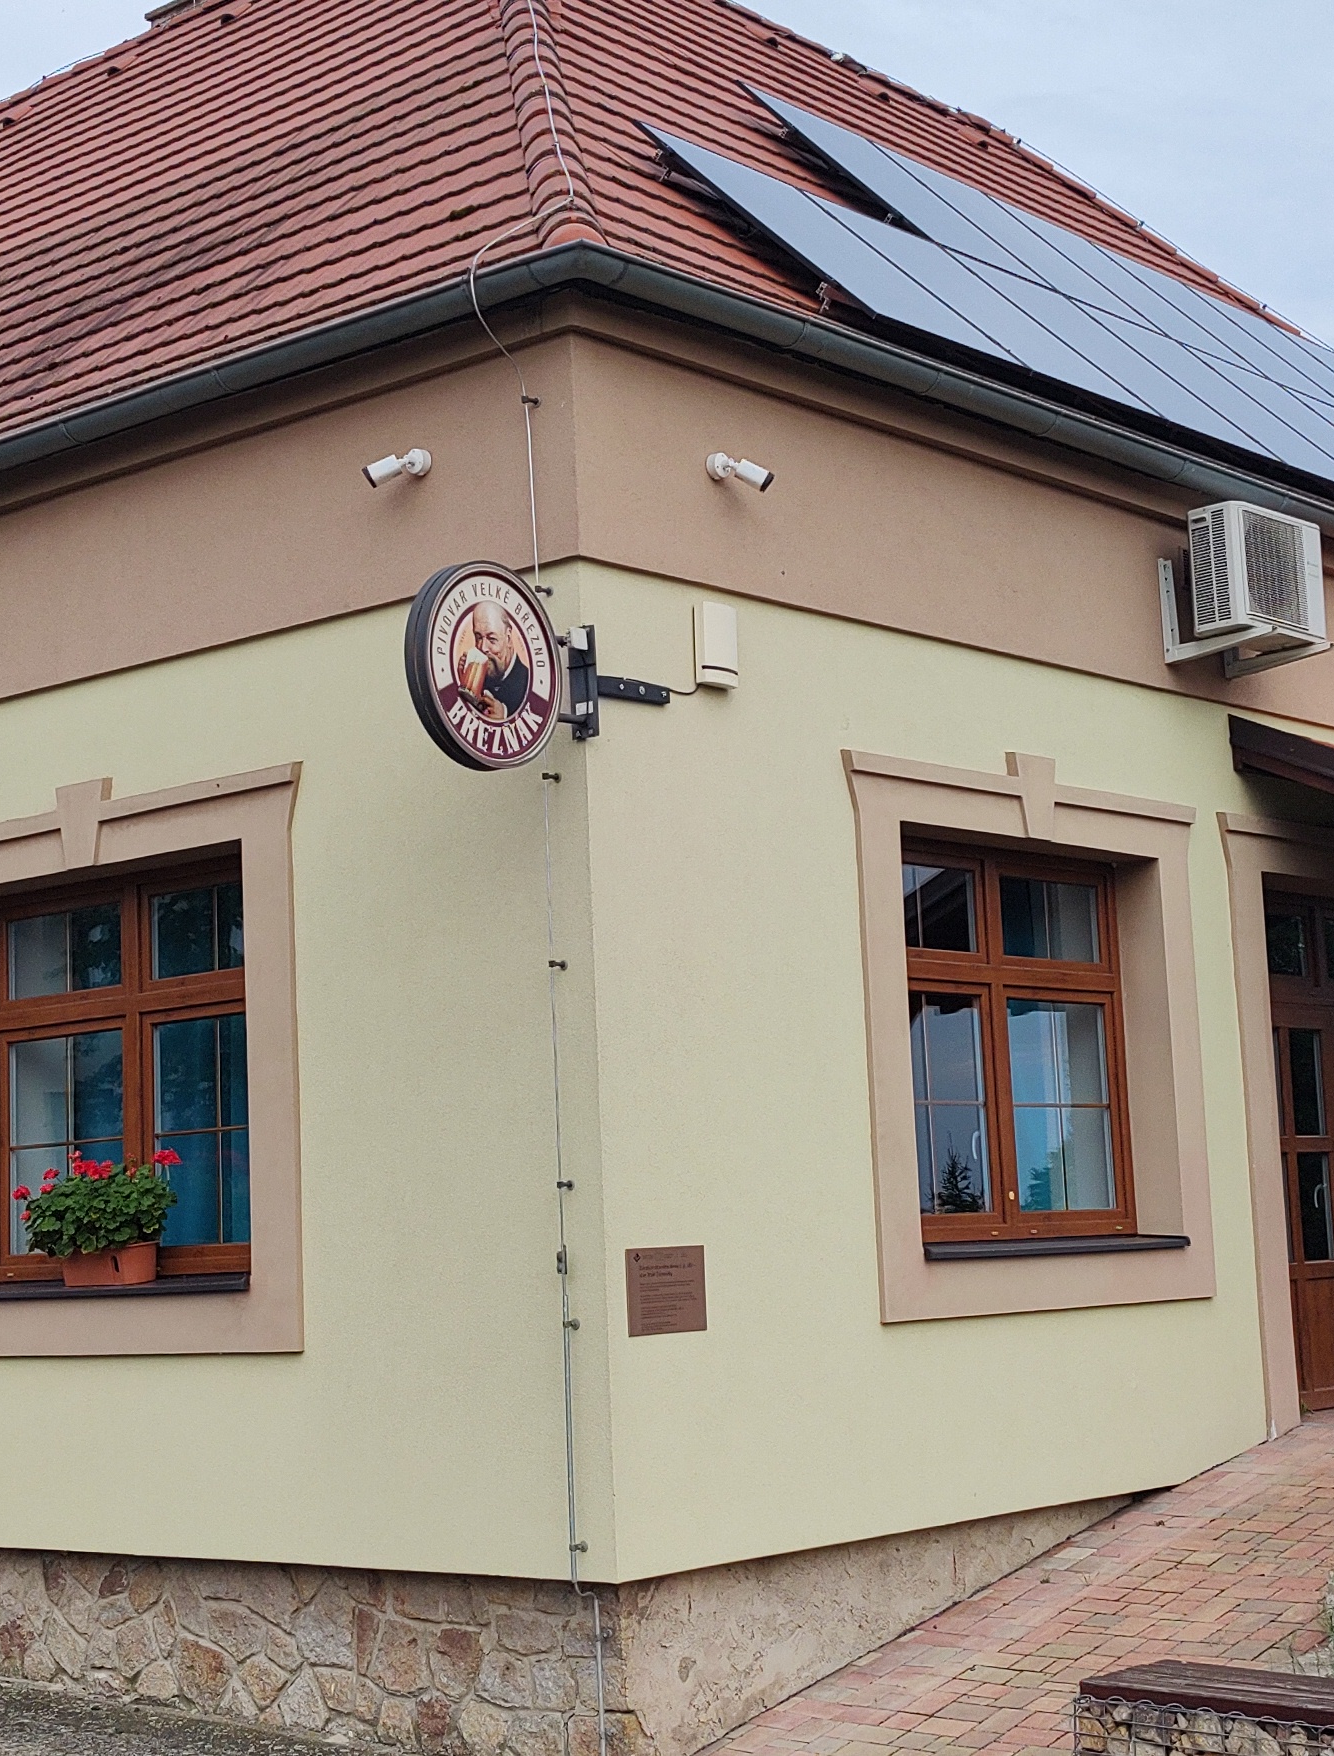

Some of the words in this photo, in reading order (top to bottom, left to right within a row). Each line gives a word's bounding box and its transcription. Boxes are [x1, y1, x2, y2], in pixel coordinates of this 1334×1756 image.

[436, 590, 467, 656] PIVOVAR
[471, 582, 511, 604] VELKÉ
[514, 602, 546, 668] BŘEZNO
[447, 697, 544, 756] BŘEZŇÁK
